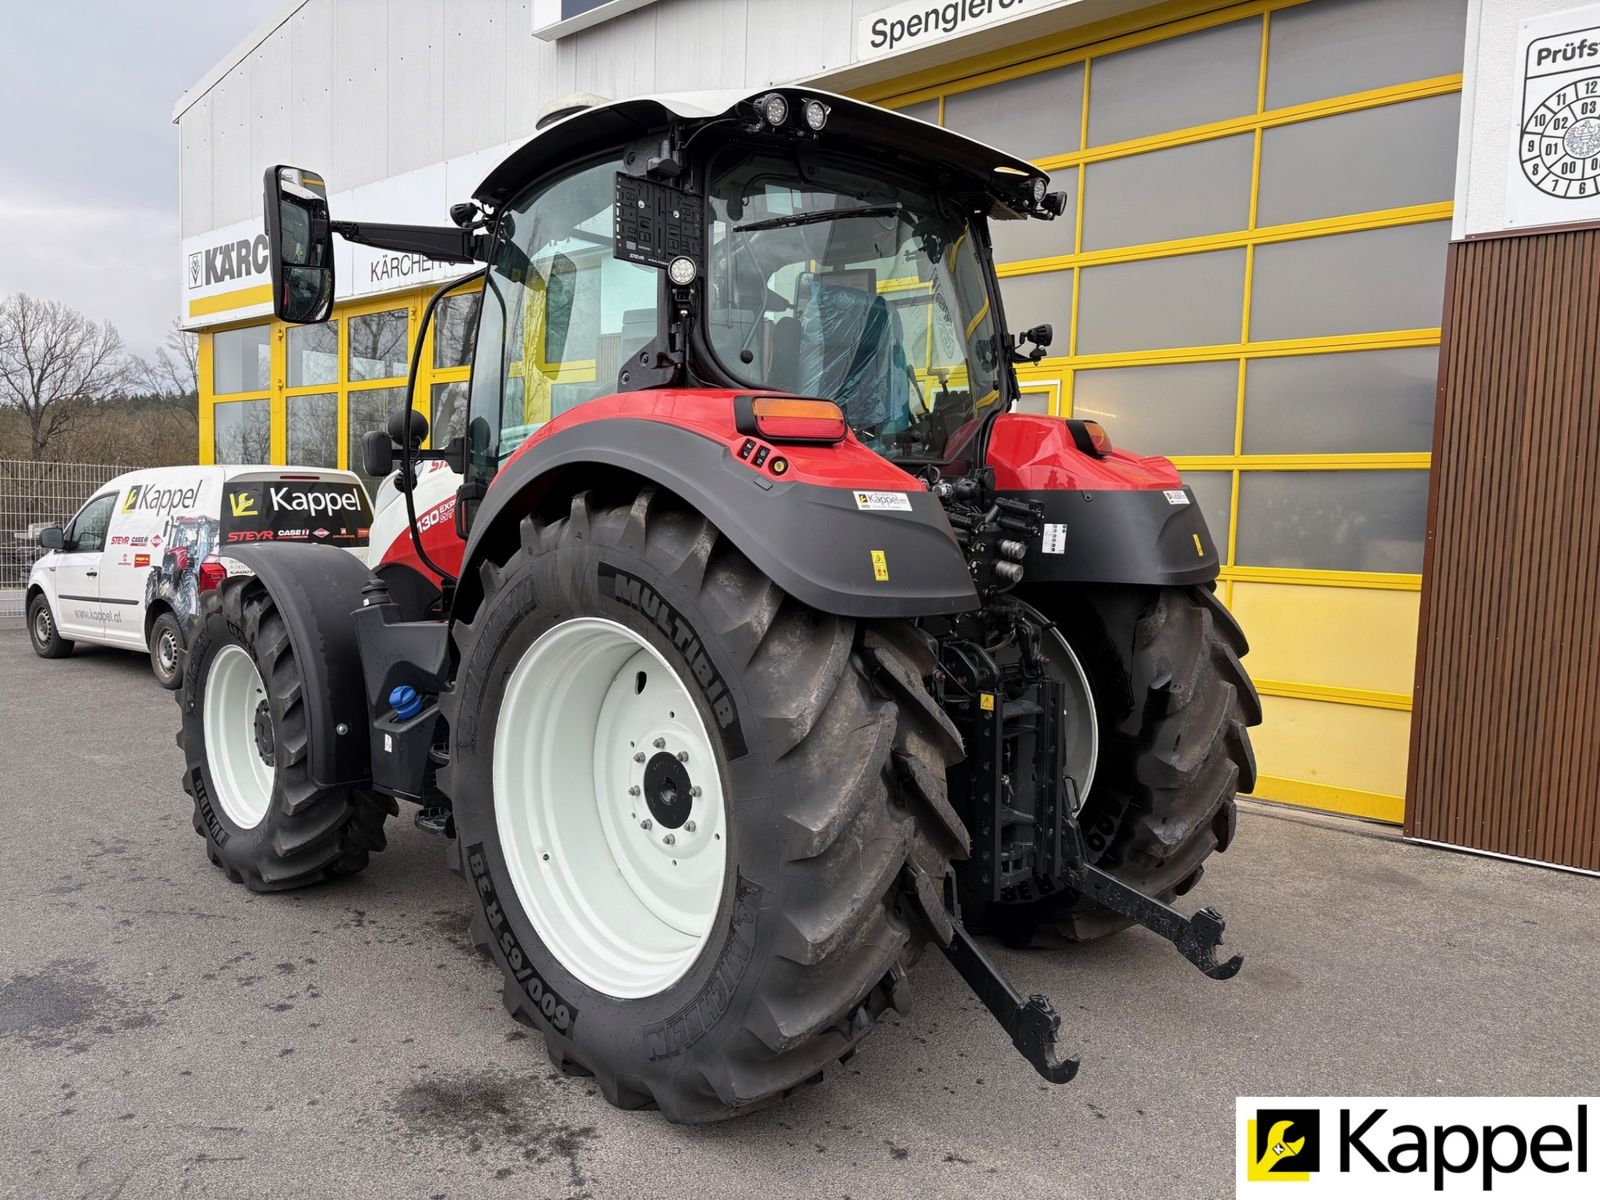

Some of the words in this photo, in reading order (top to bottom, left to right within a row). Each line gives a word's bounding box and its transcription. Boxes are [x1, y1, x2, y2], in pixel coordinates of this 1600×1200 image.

[1537, 39, 1600, 66] Prüfs
[1585, 81, 1598, 95] 12
[1556, 93, 1566, 106] 11
[1581, 101, 1597, 115] 03
[1534, 114, 1546, 127] 10
[1553, 117, 1568, 130] 02
[1528, 140, 1535, 152] 9
[1545, 142, 1558, 156] 01
[1532, 163, 1539, 176] 8
[1561, 161, 1576, 175] 00
[1591, 158, 1600, 170] 0
[1552, 179, 1559, 192] 7
[1579, 182, 1586, 194] 6
[205, 236, 269, 286] KÄRC
[139, 479, 203, 517] Kappel
[270, 487, 361, 516] Kappel
[409, 510, 440, 540] 130
[227, 530, 274, 542] STEYR
[614, 572, 737, 729] MULTIBIB
[469, 852, 496, 899] 38
[485, 902, 503, 930] R
[498, 931, 571, 1031] 600/65
